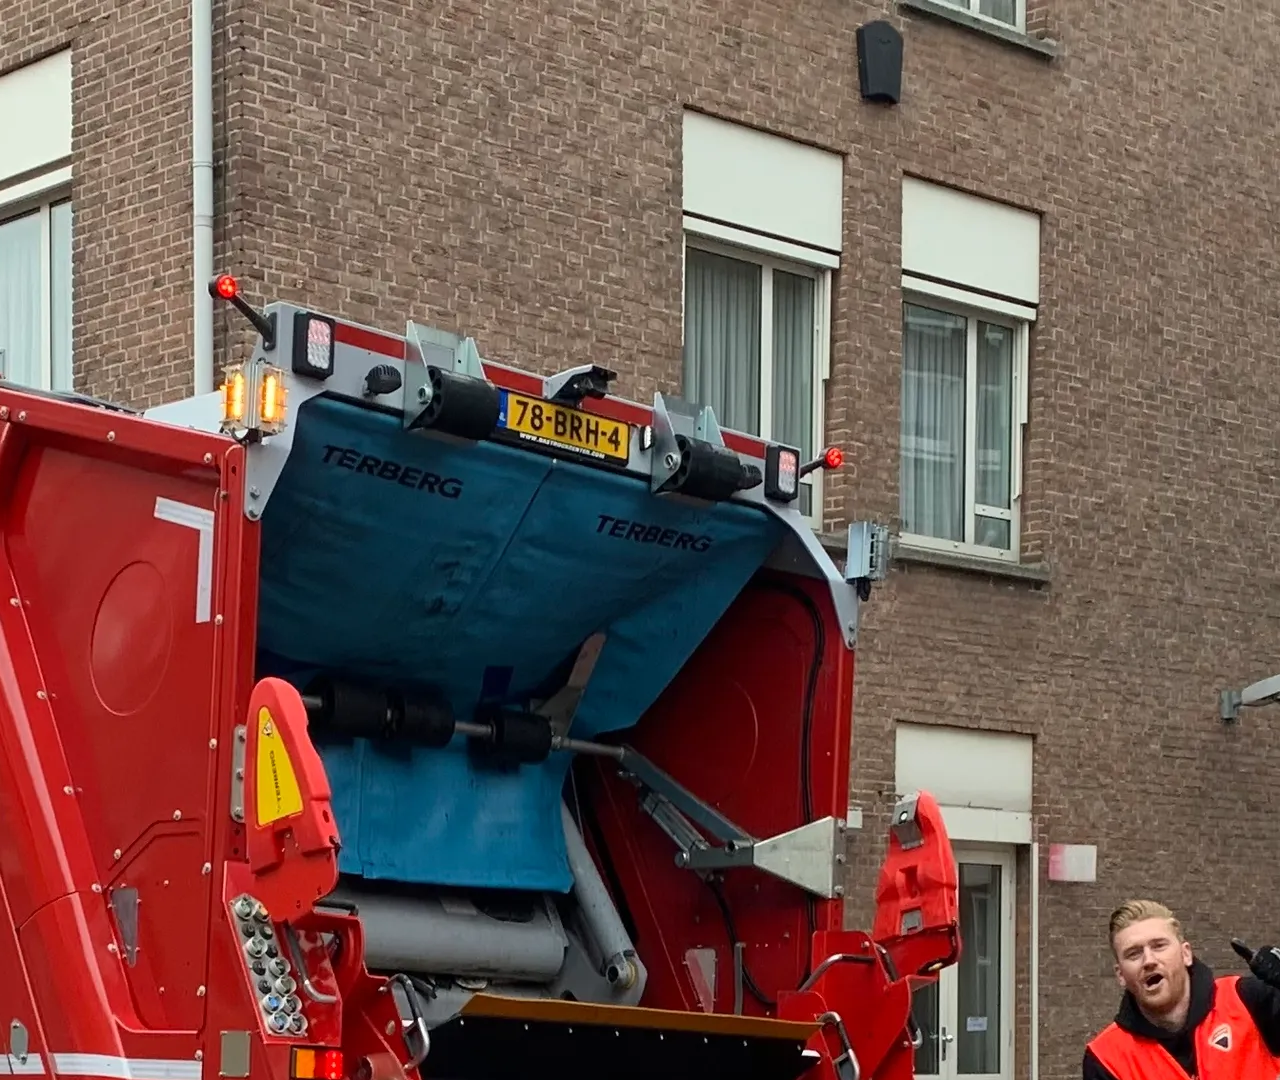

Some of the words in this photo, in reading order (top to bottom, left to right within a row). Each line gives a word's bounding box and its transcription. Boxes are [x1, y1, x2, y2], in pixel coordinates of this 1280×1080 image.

[516, 400, 620, 452] 78-BRH-4
[322, 444, 464, 499] TERBERG
[596, 514, 712, 552] TERBERG
